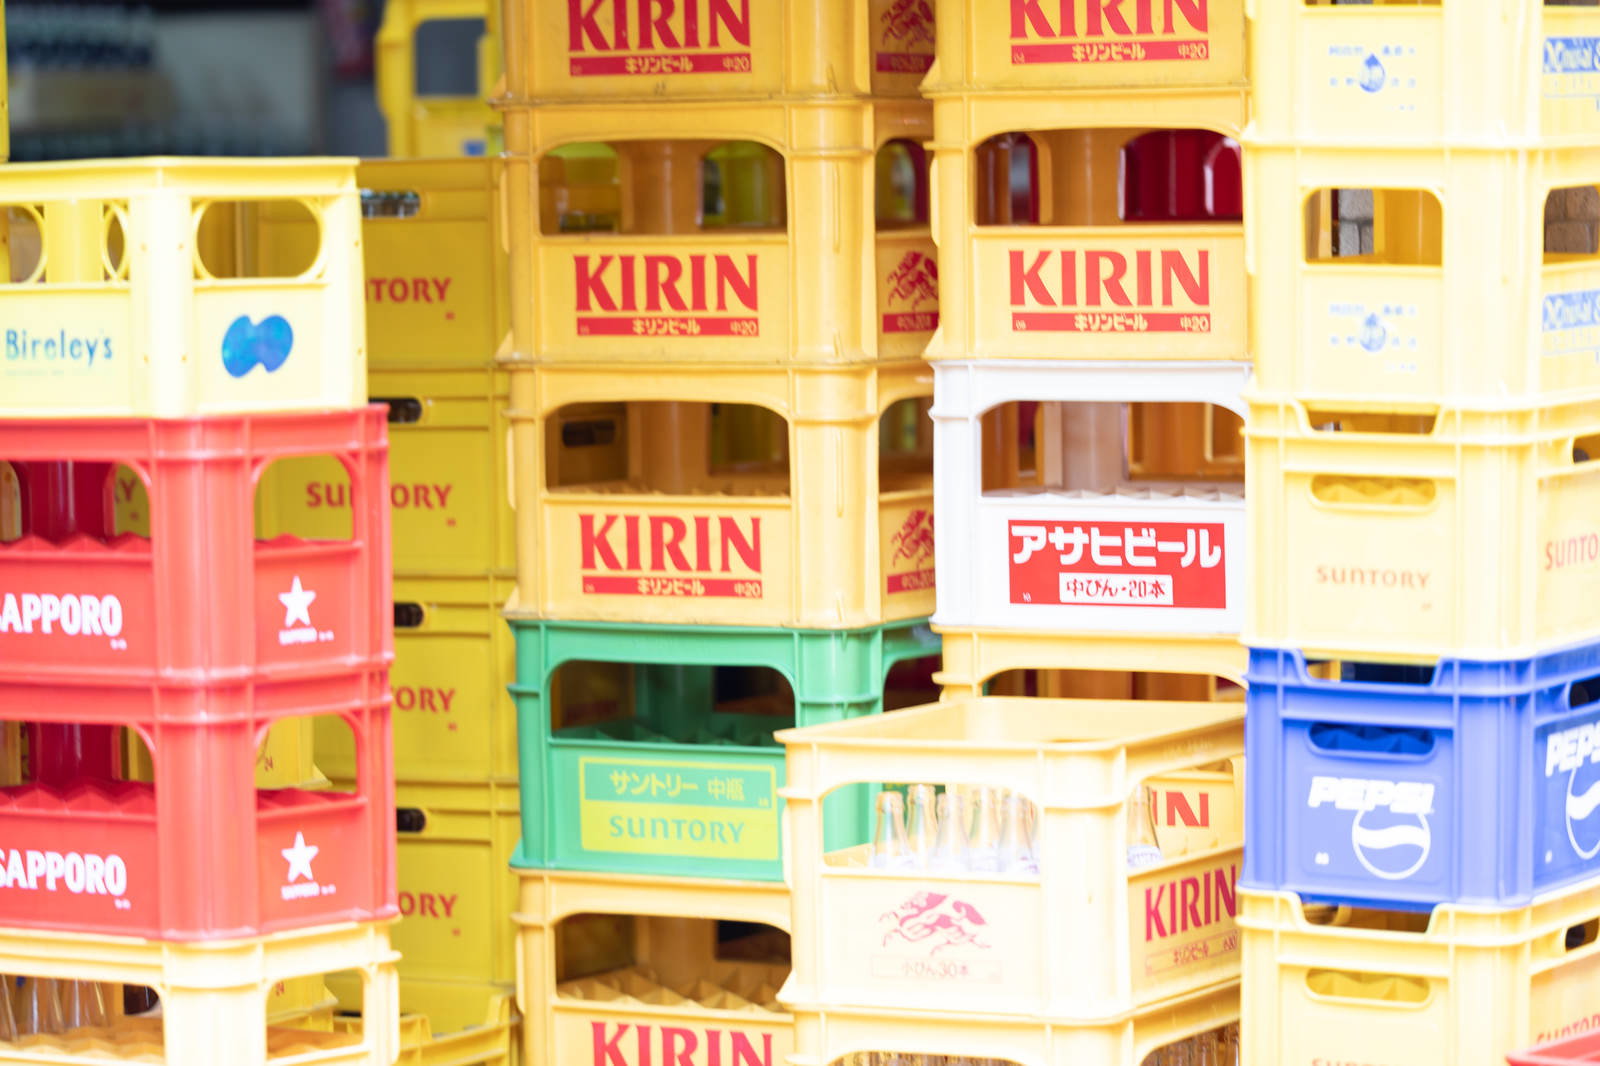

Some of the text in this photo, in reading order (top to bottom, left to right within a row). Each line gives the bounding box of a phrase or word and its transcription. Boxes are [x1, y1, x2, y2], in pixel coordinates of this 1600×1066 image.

[568, 0, 750, 52] KIRIN
[1010, 0, 1208, 38] KIRIN
[625, 56, 693, 75] キリンビール
[1072, 43, 1145, 61] キリンビール
[365, 277, 452, 304] TORY
[573, 255, 758, 313] KIRIN
[1009, 250, 1209, 307] KIRIN
[632, 318, 701, 335] キリンビール
[1074, 314, 1148, 332] キリンビール
[306, 482, 452, 509] SUORY
[578, 514, 763, 574] KIRIN
[1011, 525, 1222, 568] アサヒビール
[637, 578, 705, 596] キリンビール
[1317, 565, 1432, 588] SUNTORY
[0, 593, 123, 637] APPORO
[391, 686, 456, 713] ORY
[609, 770, 699, 798] サントリー
[1307, 776, 1435, 814] PEPSI
[609, 814, 745, 845] SUNTORY
[1145, 864, 1237, 943] KIRIN
[591, 1021, 772, 1066] KIRIN
